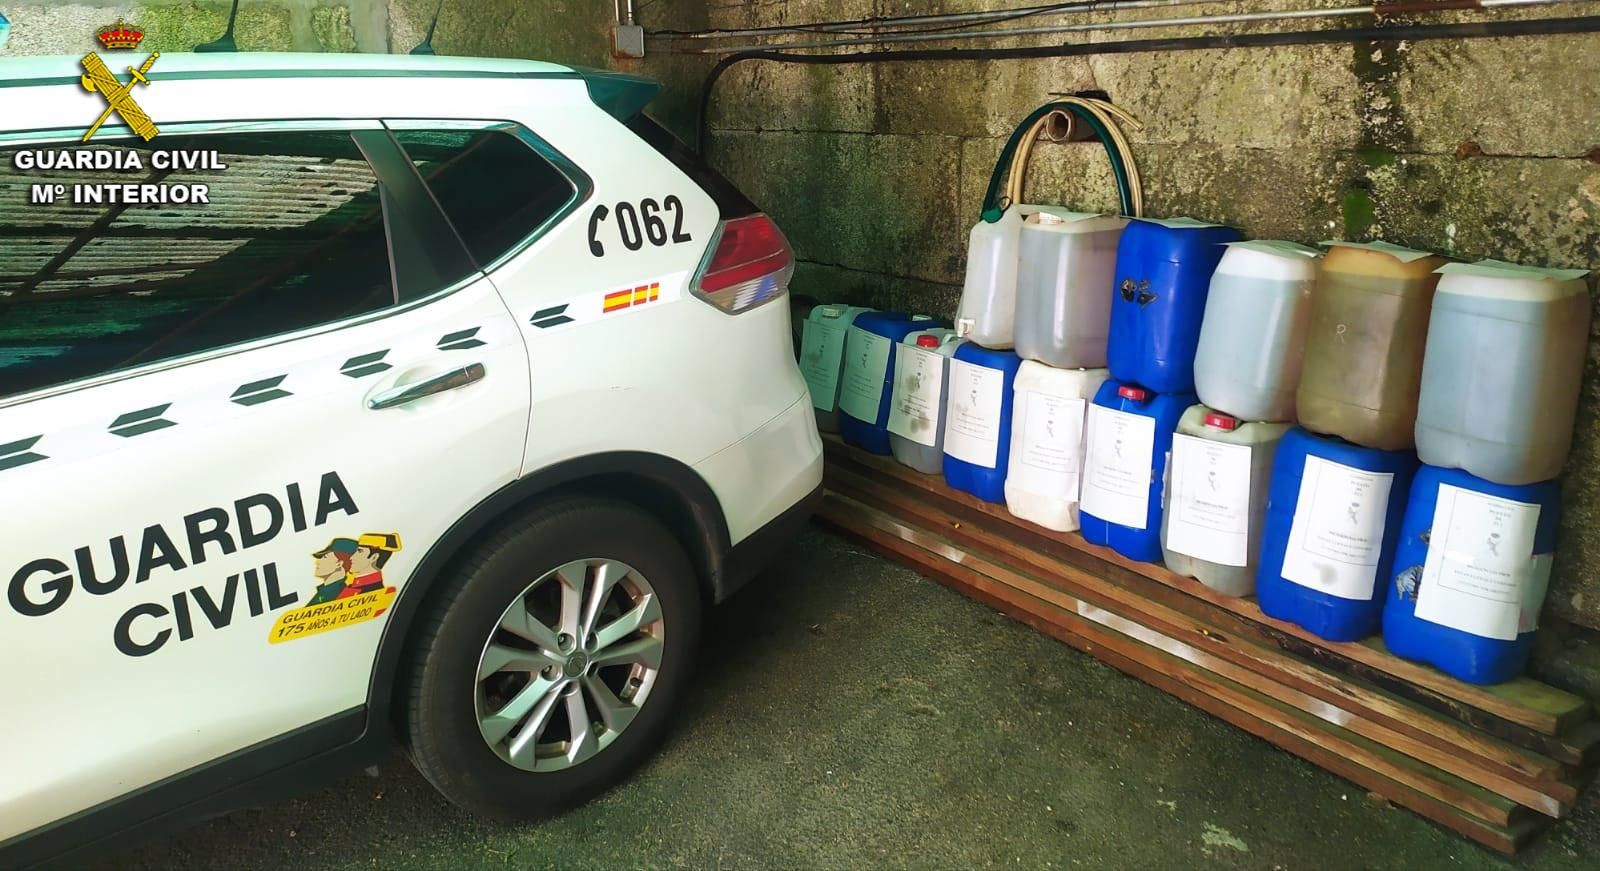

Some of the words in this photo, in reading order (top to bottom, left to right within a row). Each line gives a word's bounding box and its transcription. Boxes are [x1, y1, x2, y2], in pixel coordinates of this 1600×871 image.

[615, 194, 692, 251] 062
[7, 470, 359, 617] GUARDIA
[113, 562, 299, 657] CIVIL
[278, 622, 306, 638] 175
[305, 618, 330, 632] AÑOS
[329, 616, 337, 626] A
[338, 613, 351, 623] TU
[349, 607, 372, 620] LADO
[282, 602, 344, 624] GUARDIA
[347, 593, 378, 609] CIVIL
